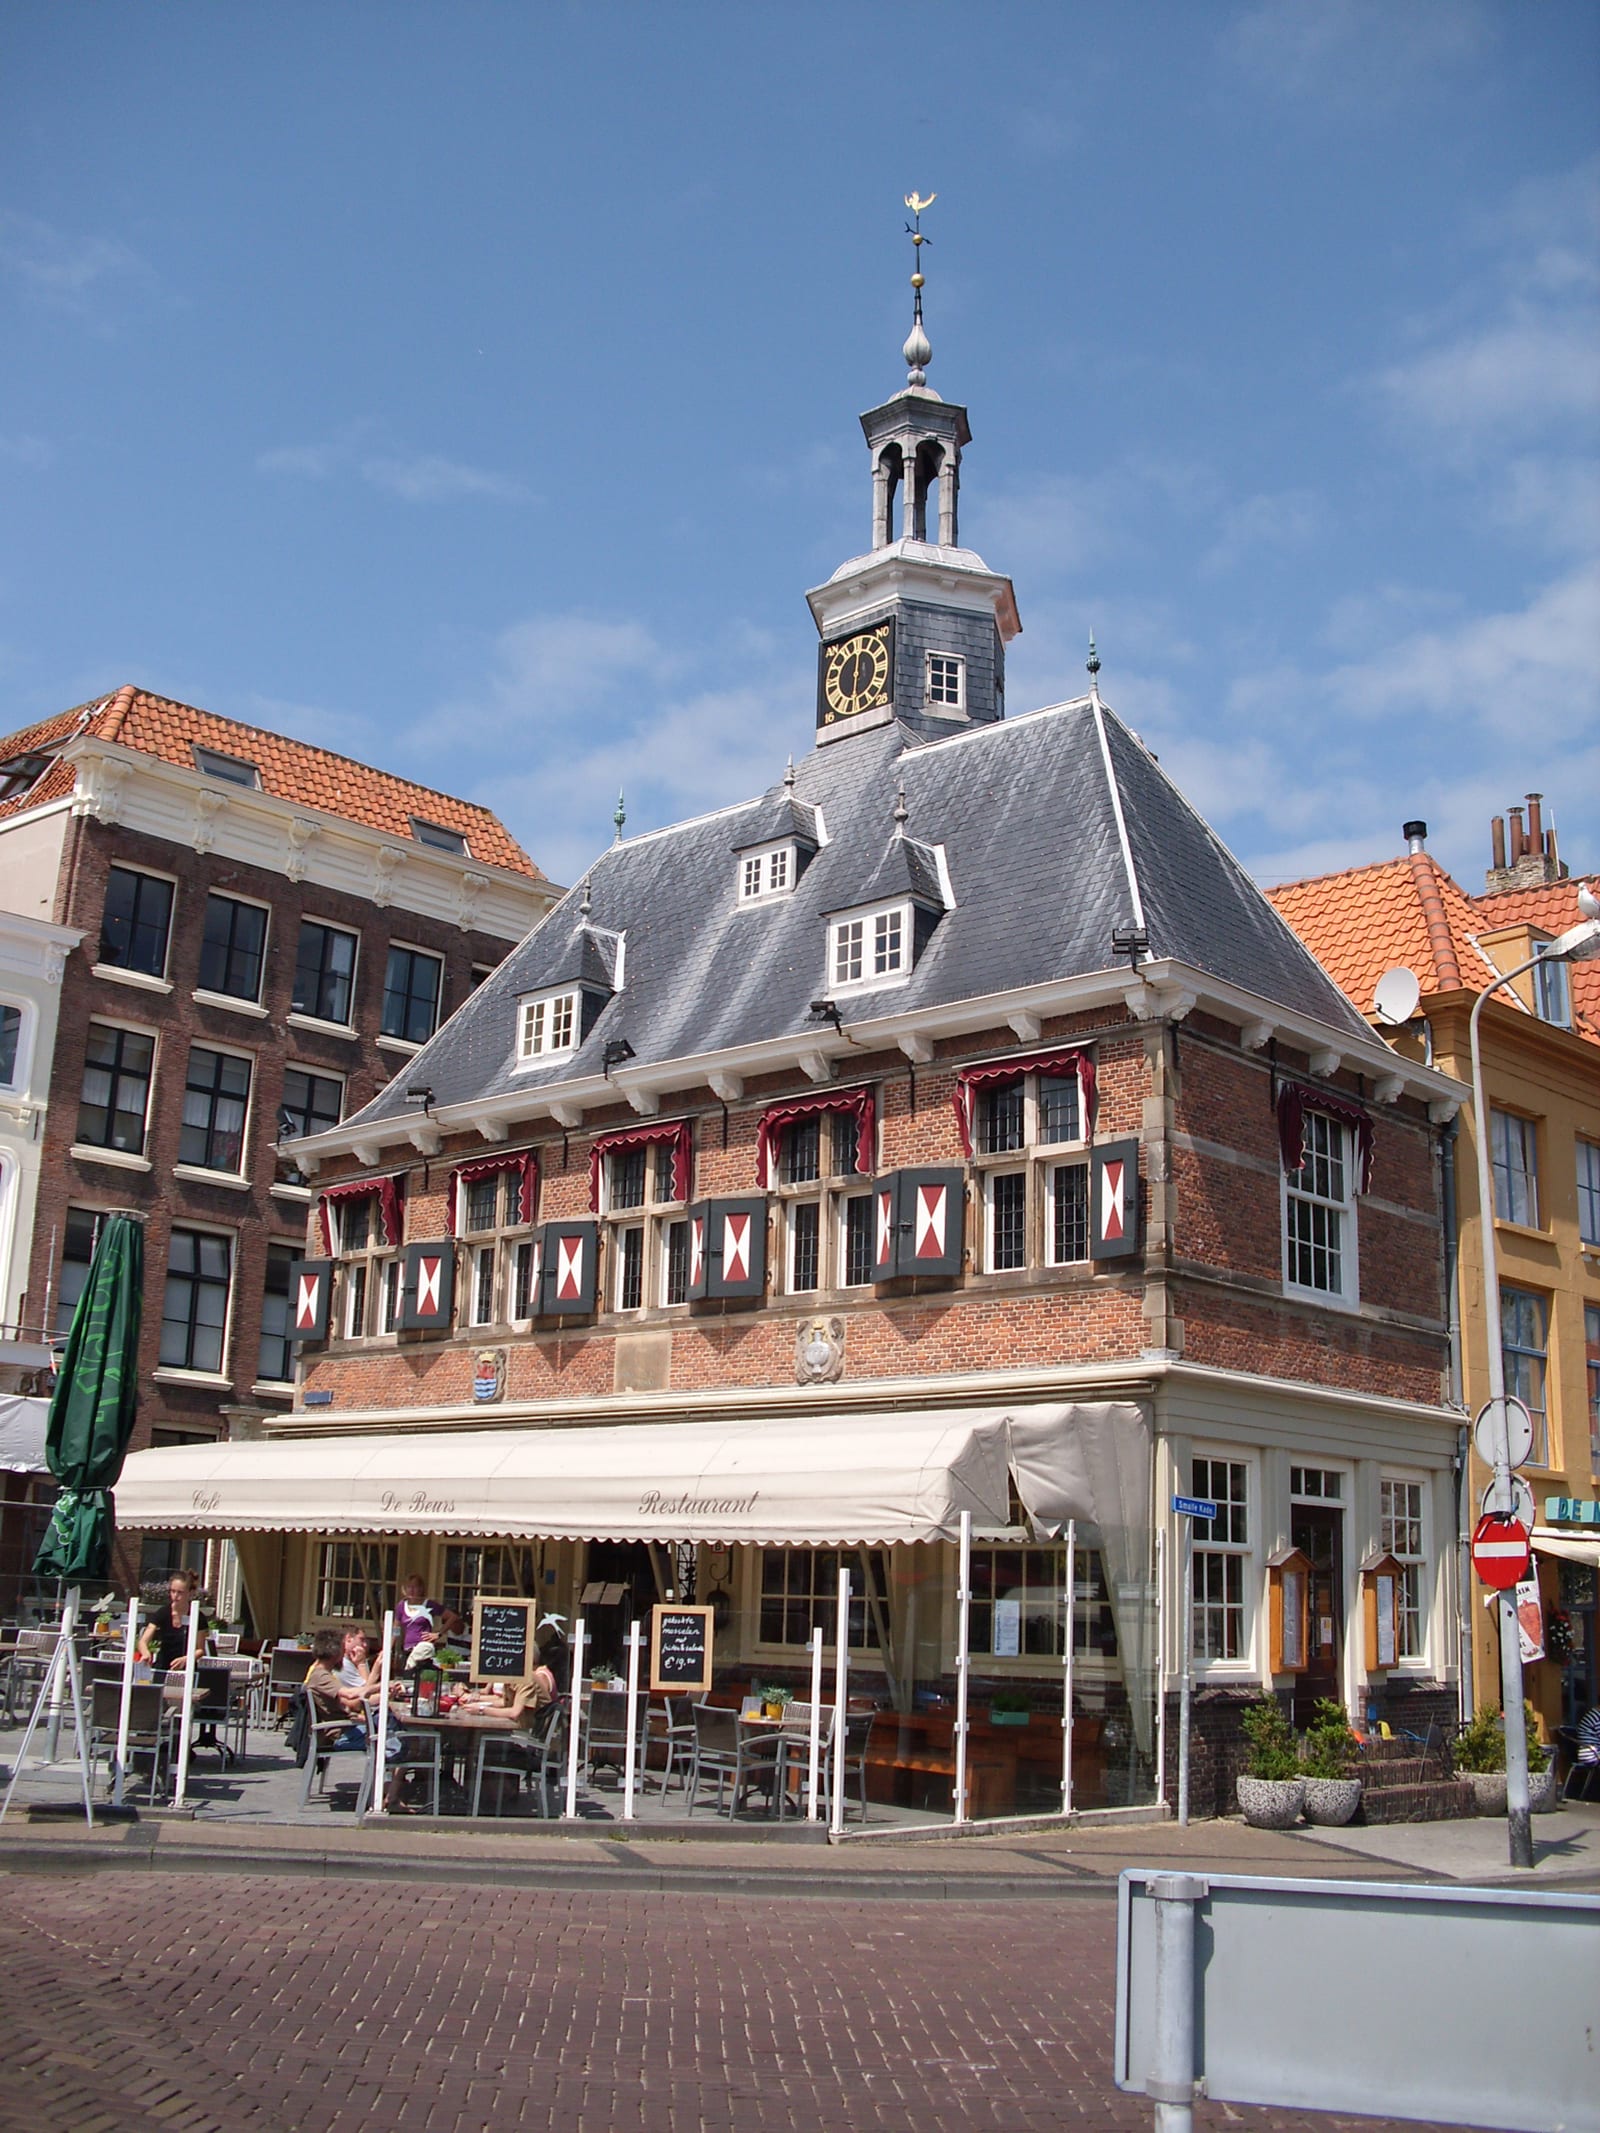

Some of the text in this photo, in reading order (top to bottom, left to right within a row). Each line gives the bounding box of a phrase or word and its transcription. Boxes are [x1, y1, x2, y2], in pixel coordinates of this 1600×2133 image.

[875, 626, 890, 640] NO
[824, 711, 835, 724] 16
[191, 1489, 760, 1515] Café De Beurs Restaurant
